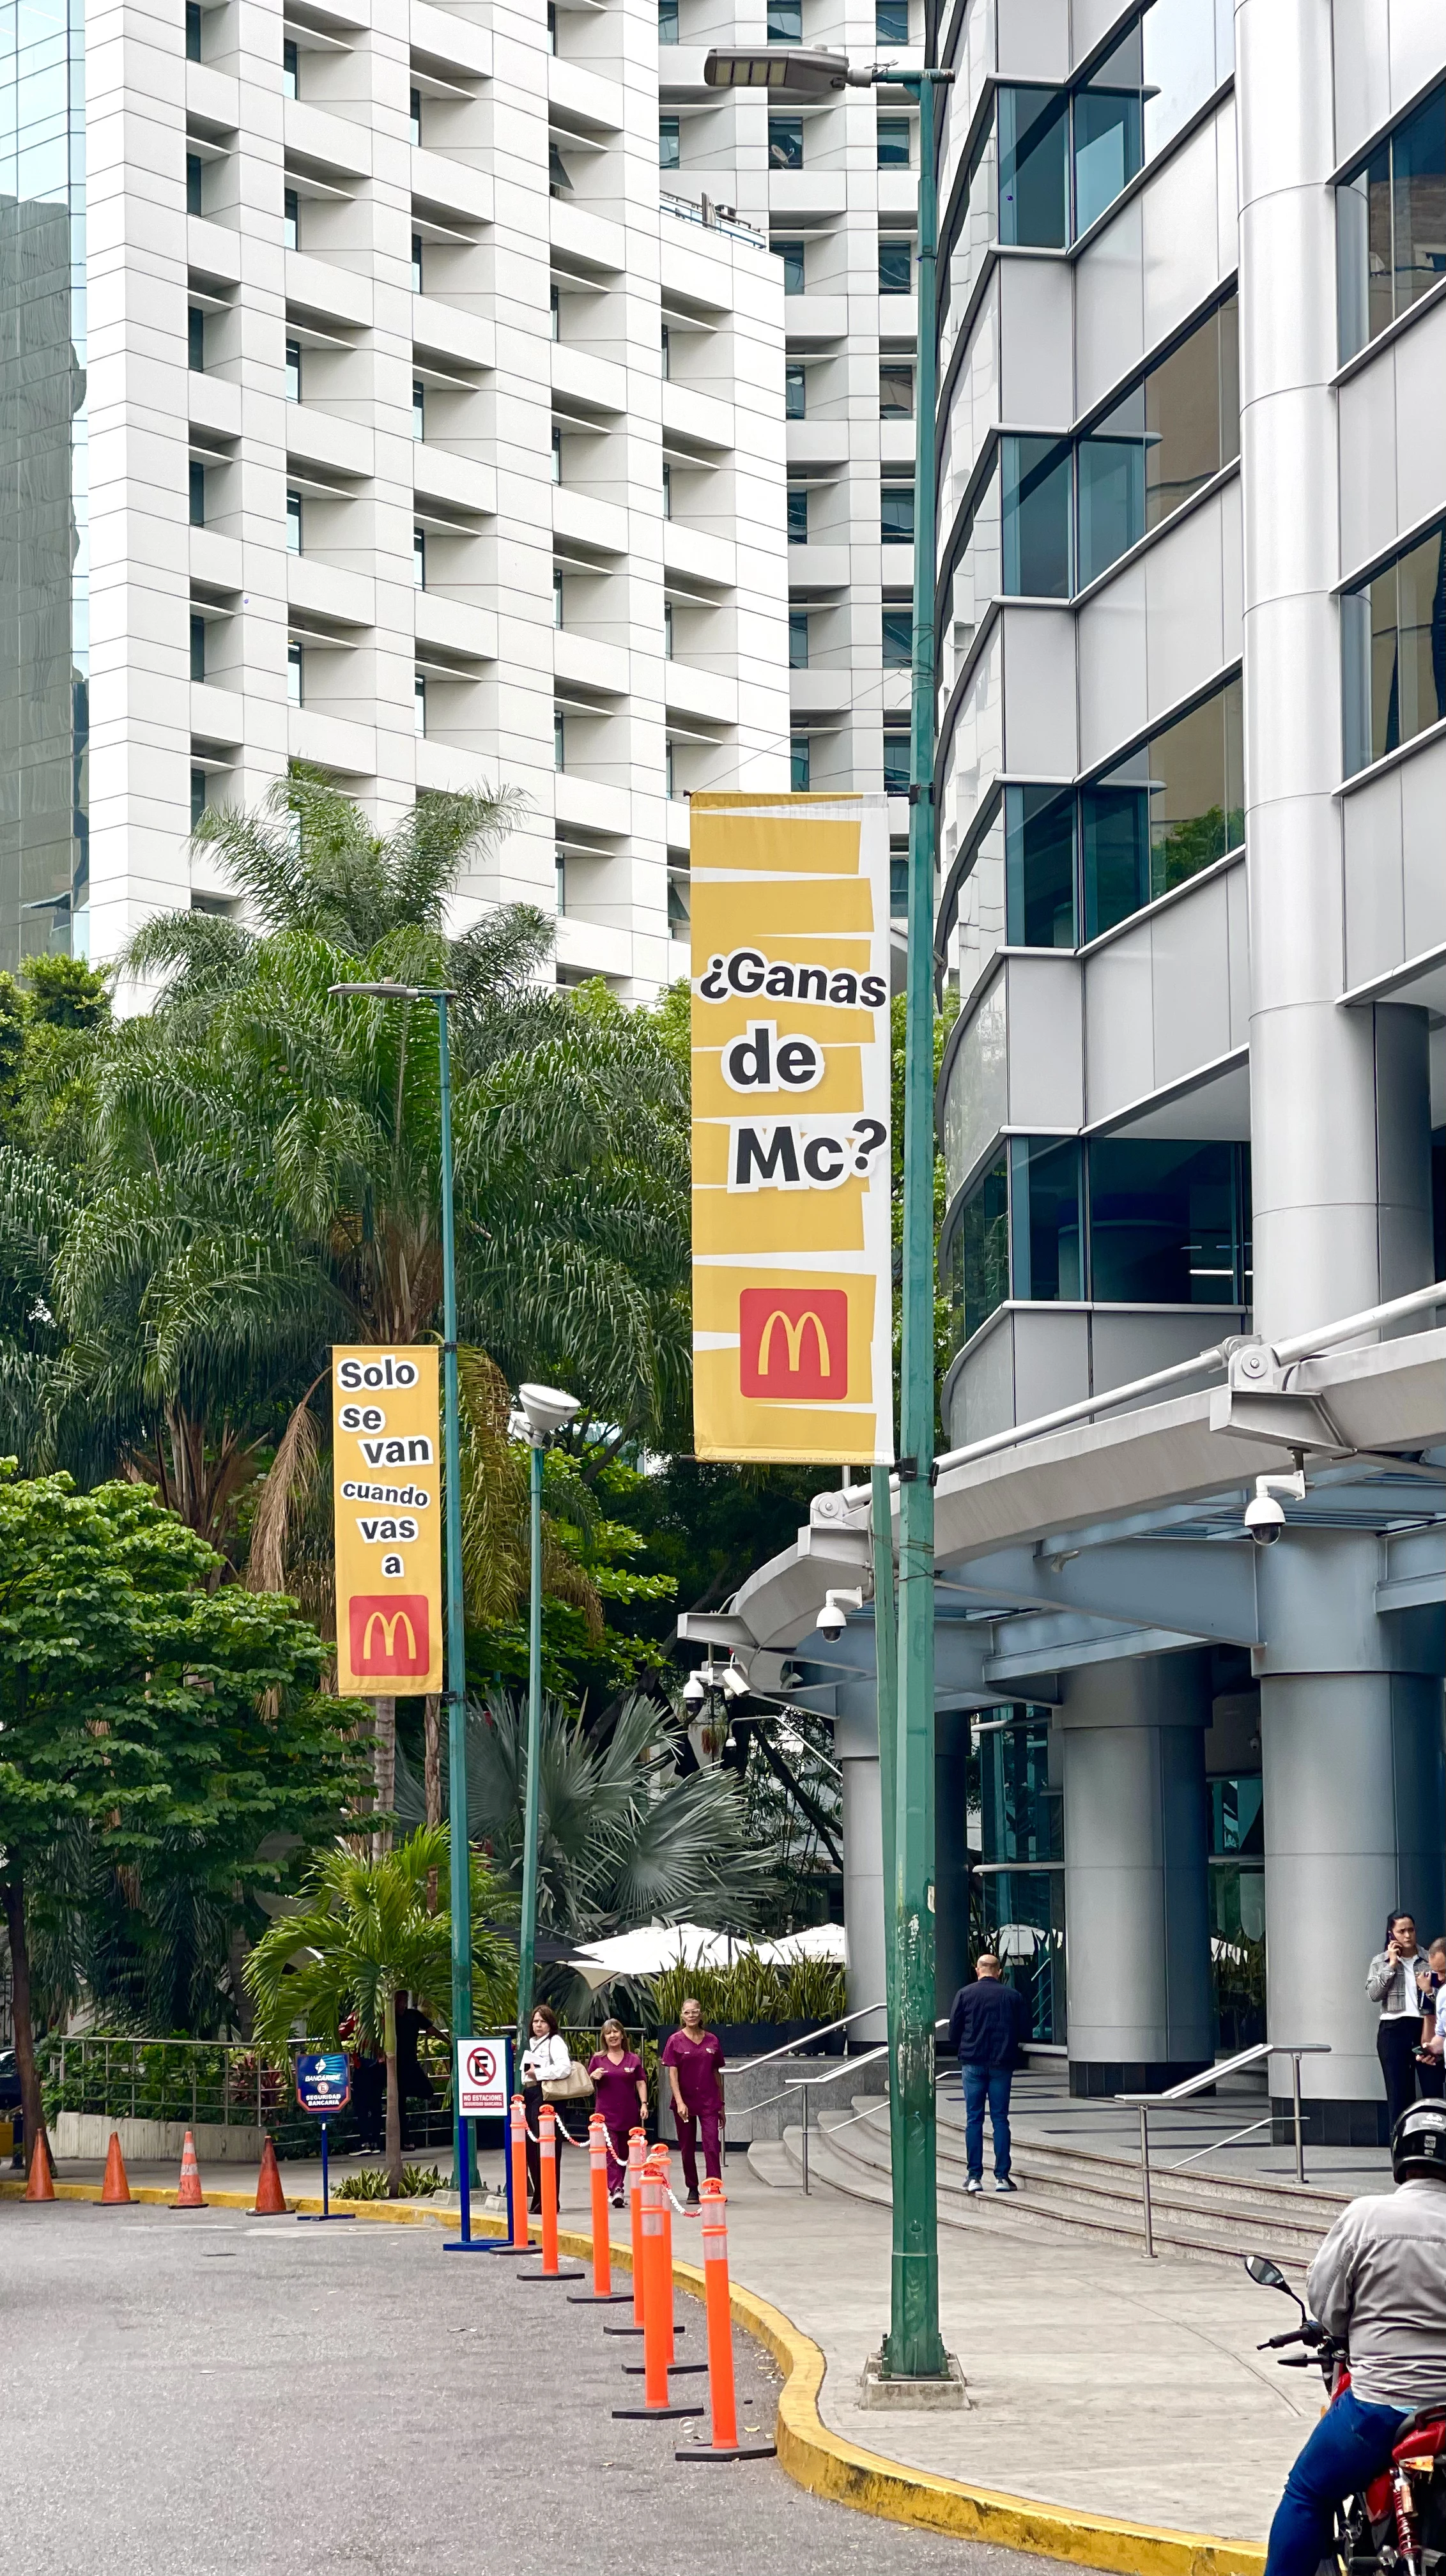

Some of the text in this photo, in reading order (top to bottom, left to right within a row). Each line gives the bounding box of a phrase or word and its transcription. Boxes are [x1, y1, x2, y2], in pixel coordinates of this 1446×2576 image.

[700, 952, 887, 1008] ¿Ganas
[729, 1028, 817, 1085] de
[735, 1119, 887, 1184] Mc?
[341, 1359, 415, 1388] Solo
[342, 1407, 381, 1430] se
[363, 1439, 429, 1464] van
[343, 1483, 428, 1506] cuando
[360, 1519, 415, 1540] vas
[385, 1556, 401, 1574] a
